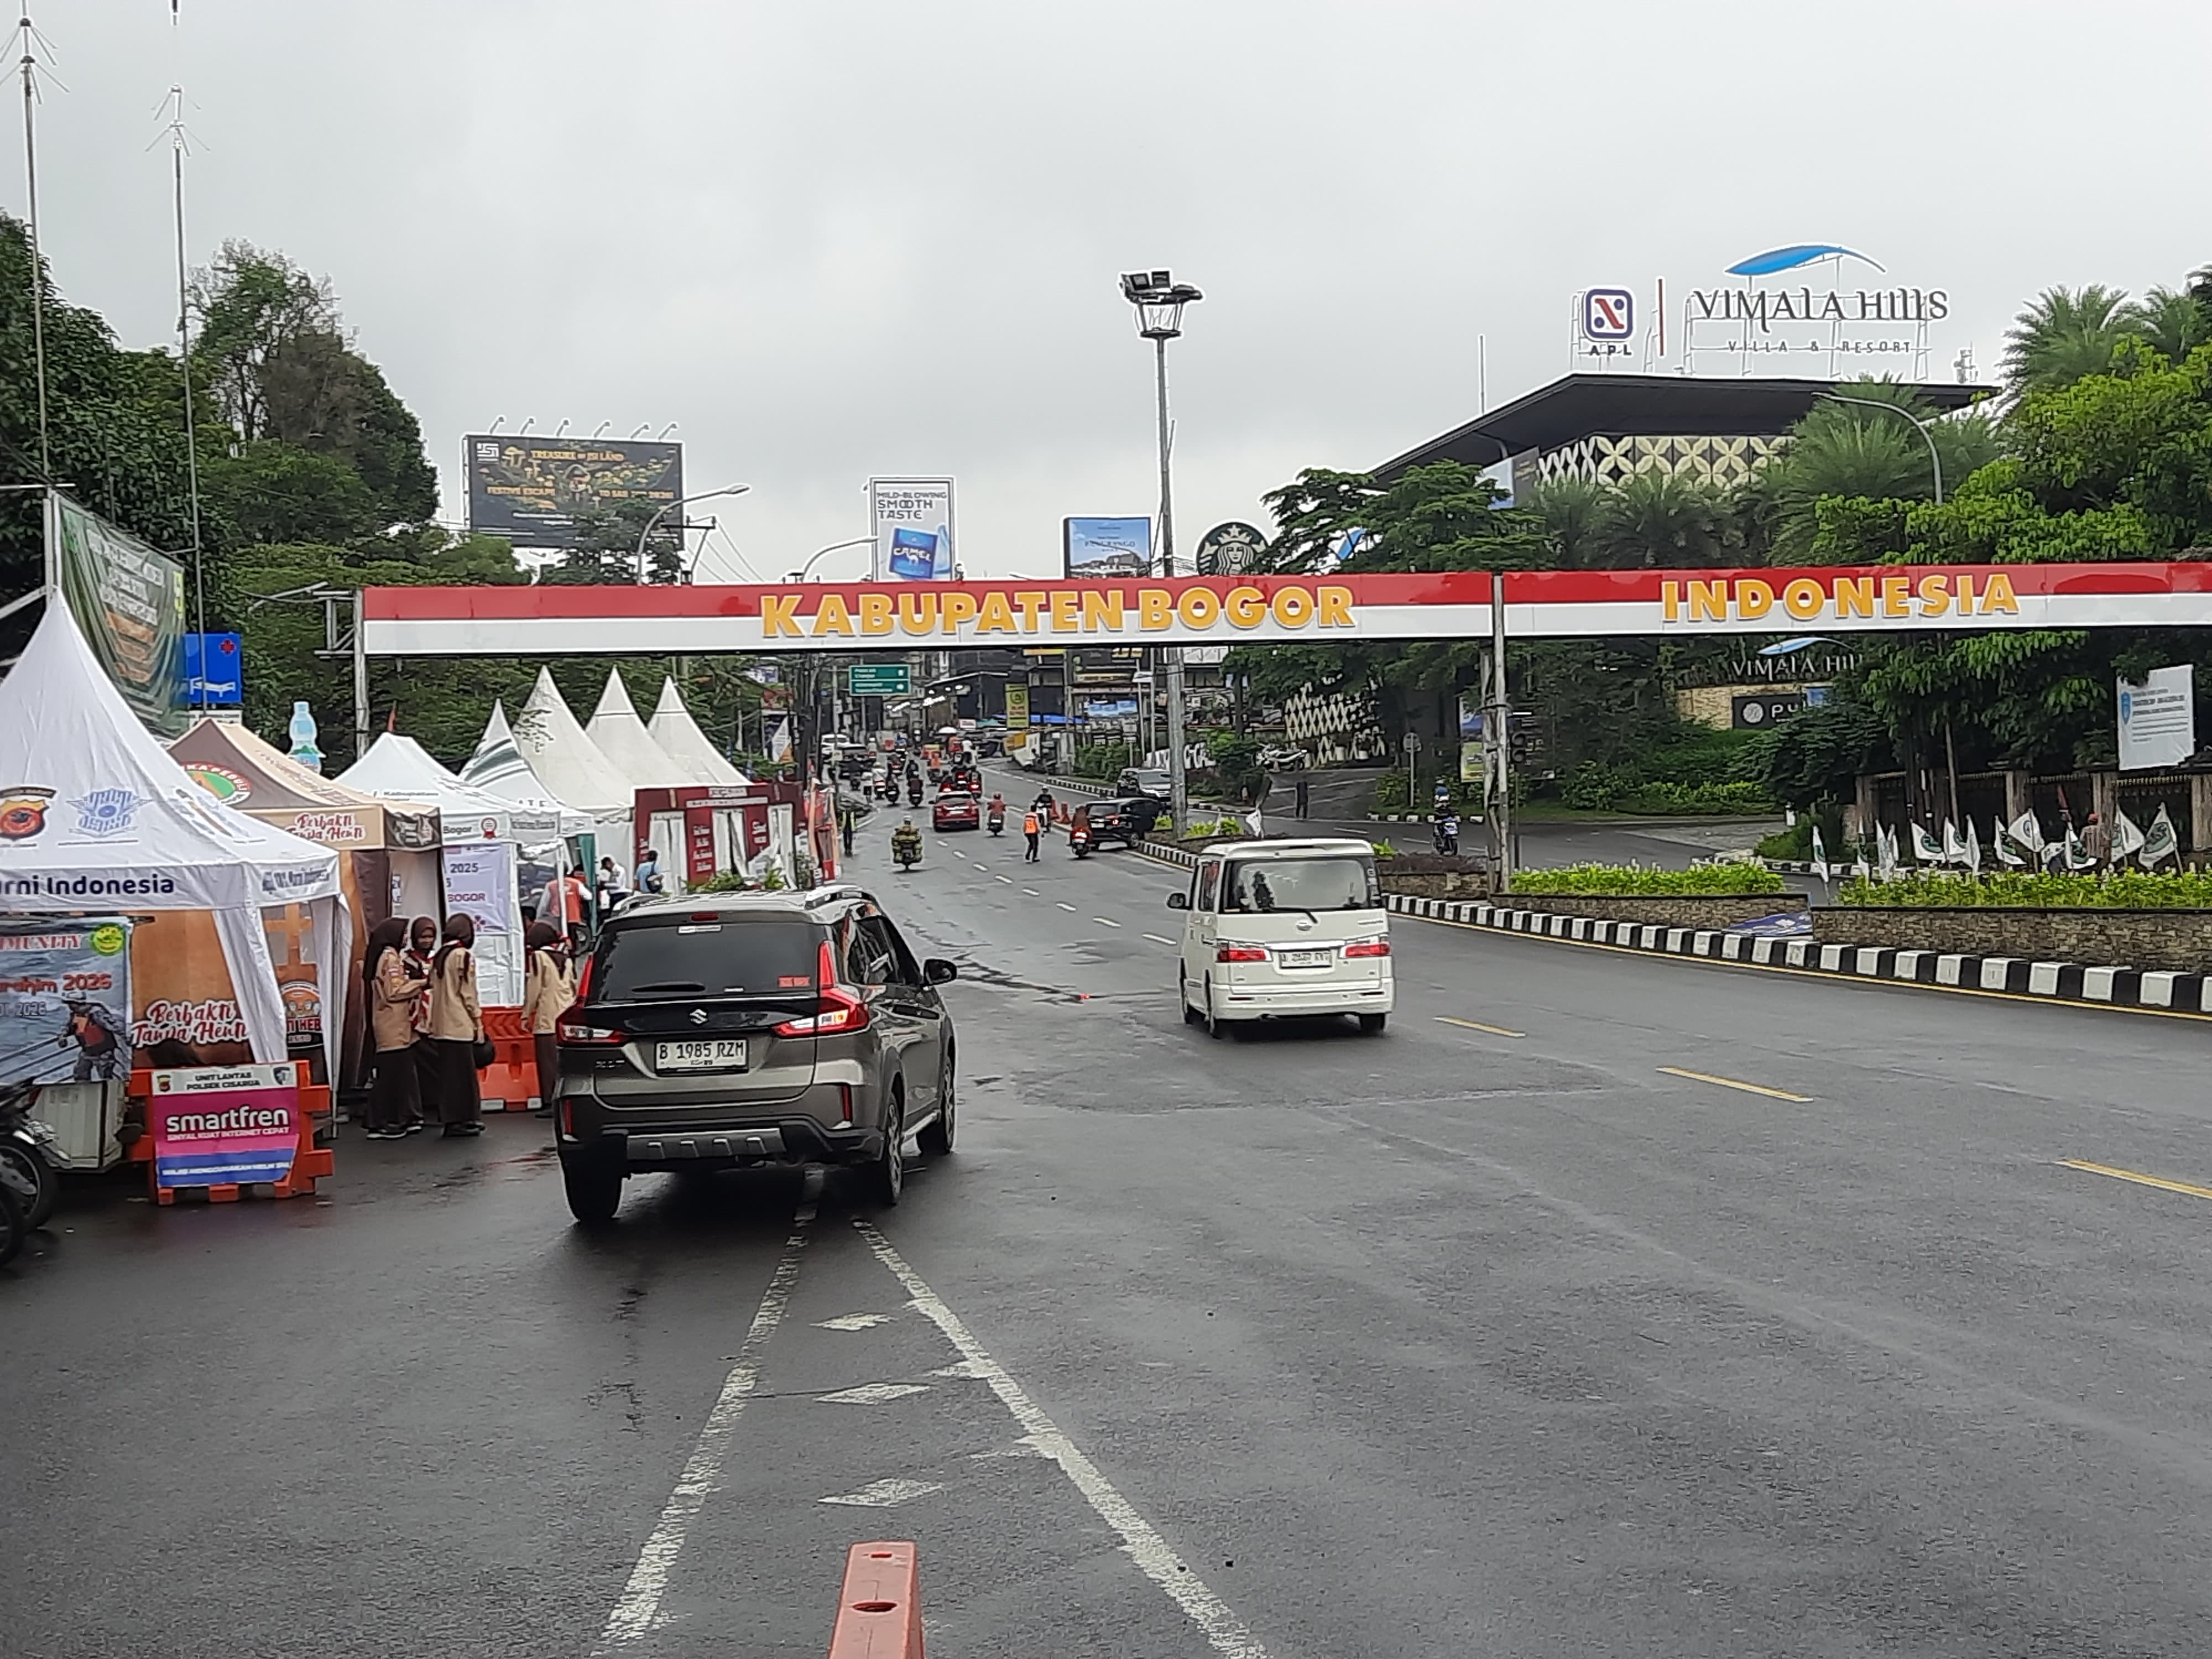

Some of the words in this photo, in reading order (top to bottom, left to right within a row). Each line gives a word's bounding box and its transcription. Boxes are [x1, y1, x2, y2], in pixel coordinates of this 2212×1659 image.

[1589, 345, 1632, 356] APL
[1728, 340, 1788, 353] VILLA
[1843, 341, 1910, 353] RESORT
[878, 499, 933, 509] SMOOTH
[878, 509, 922, 519] TASTE
[893, 546, 932, 562] CAMEL
[1661, 573, 2020, 622] INDONESIA
[760, 589, 1123, 638] KABUPATEN
[1140, 585, 1355, 632] BOGOR
[450, 863, 479, 874] 2025
[0, 875, 39, 895] rni
[47, 874, 174, 895] Indonesia
[447, 893, 486, 902] BOGOR
[150, 1001, 236, 1024] Berbakti
[195, 1021, 247, 1042] Henti
[659, 1045, 668, 1060] B
[676, 1042, 712, 1059] 1985
[717, 1041, 744, 1058] RZM
[166, 1105, 289, 1132] smartfren
